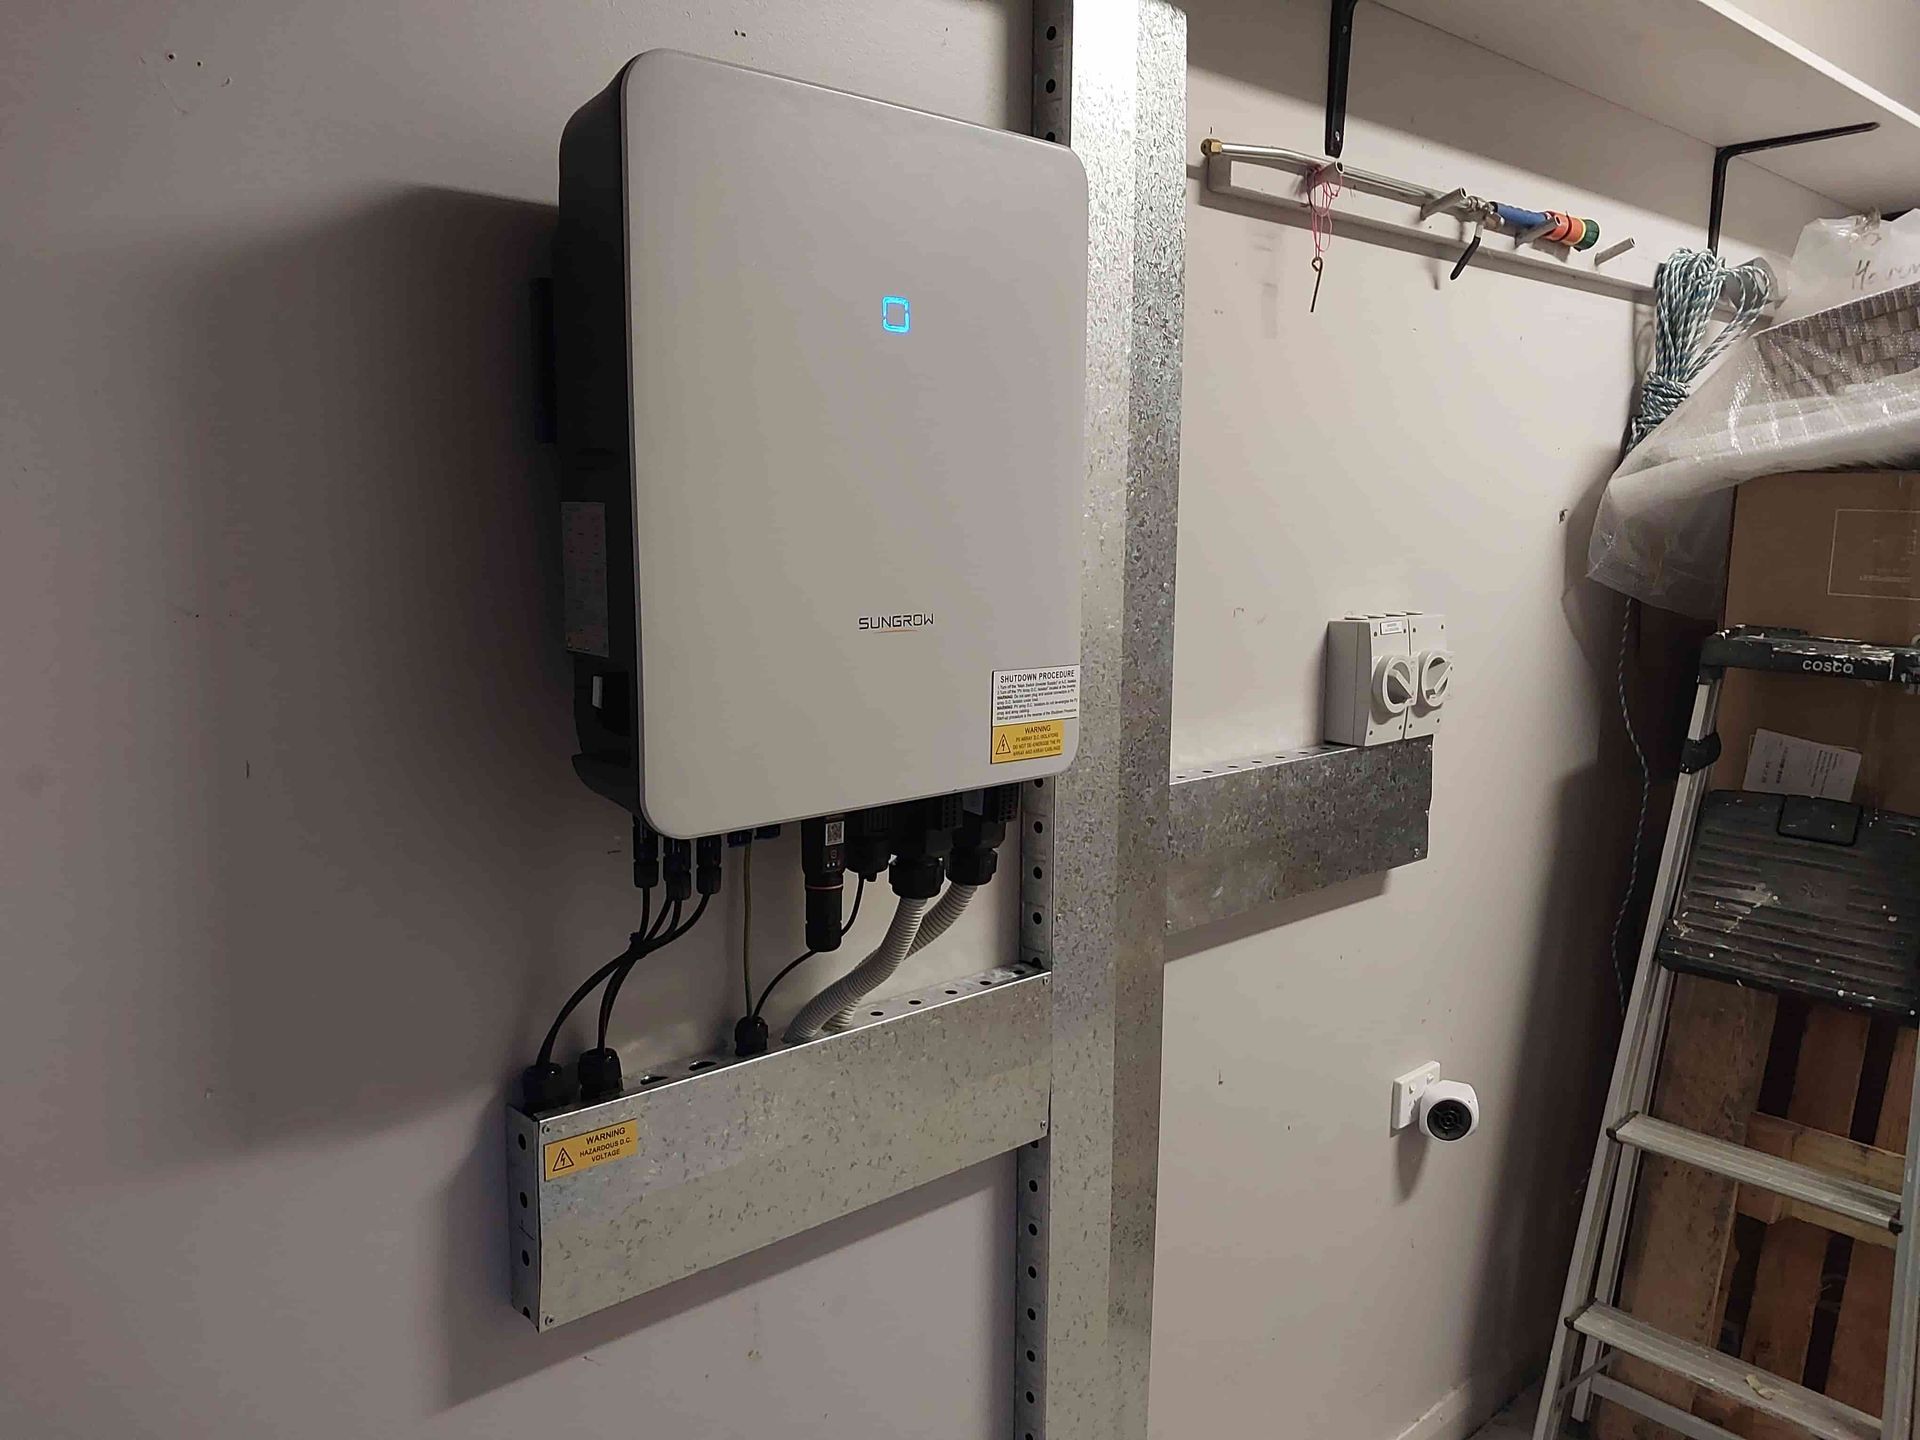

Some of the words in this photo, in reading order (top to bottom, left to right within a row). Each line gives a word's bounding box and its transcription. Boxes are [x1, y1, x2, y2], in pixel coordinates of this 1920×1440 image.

[858, 613, 934, 630] SUNGROW
[1802, 659, 1855, 674] COSCO
[1000, 673, 1037, 684] SHUTDOWN
[1038, 669, 1075, 680] PROCEDURE
[1024, 725, 1051, 734] WARNING
[586, 1127, 626, 1145] WARNING
[579, 1141, 619, 1158] HAZARDOUS
[619, 1137, 632, 1146] D.C.
[591, 1148, 620, 1162] VOLTAGE
